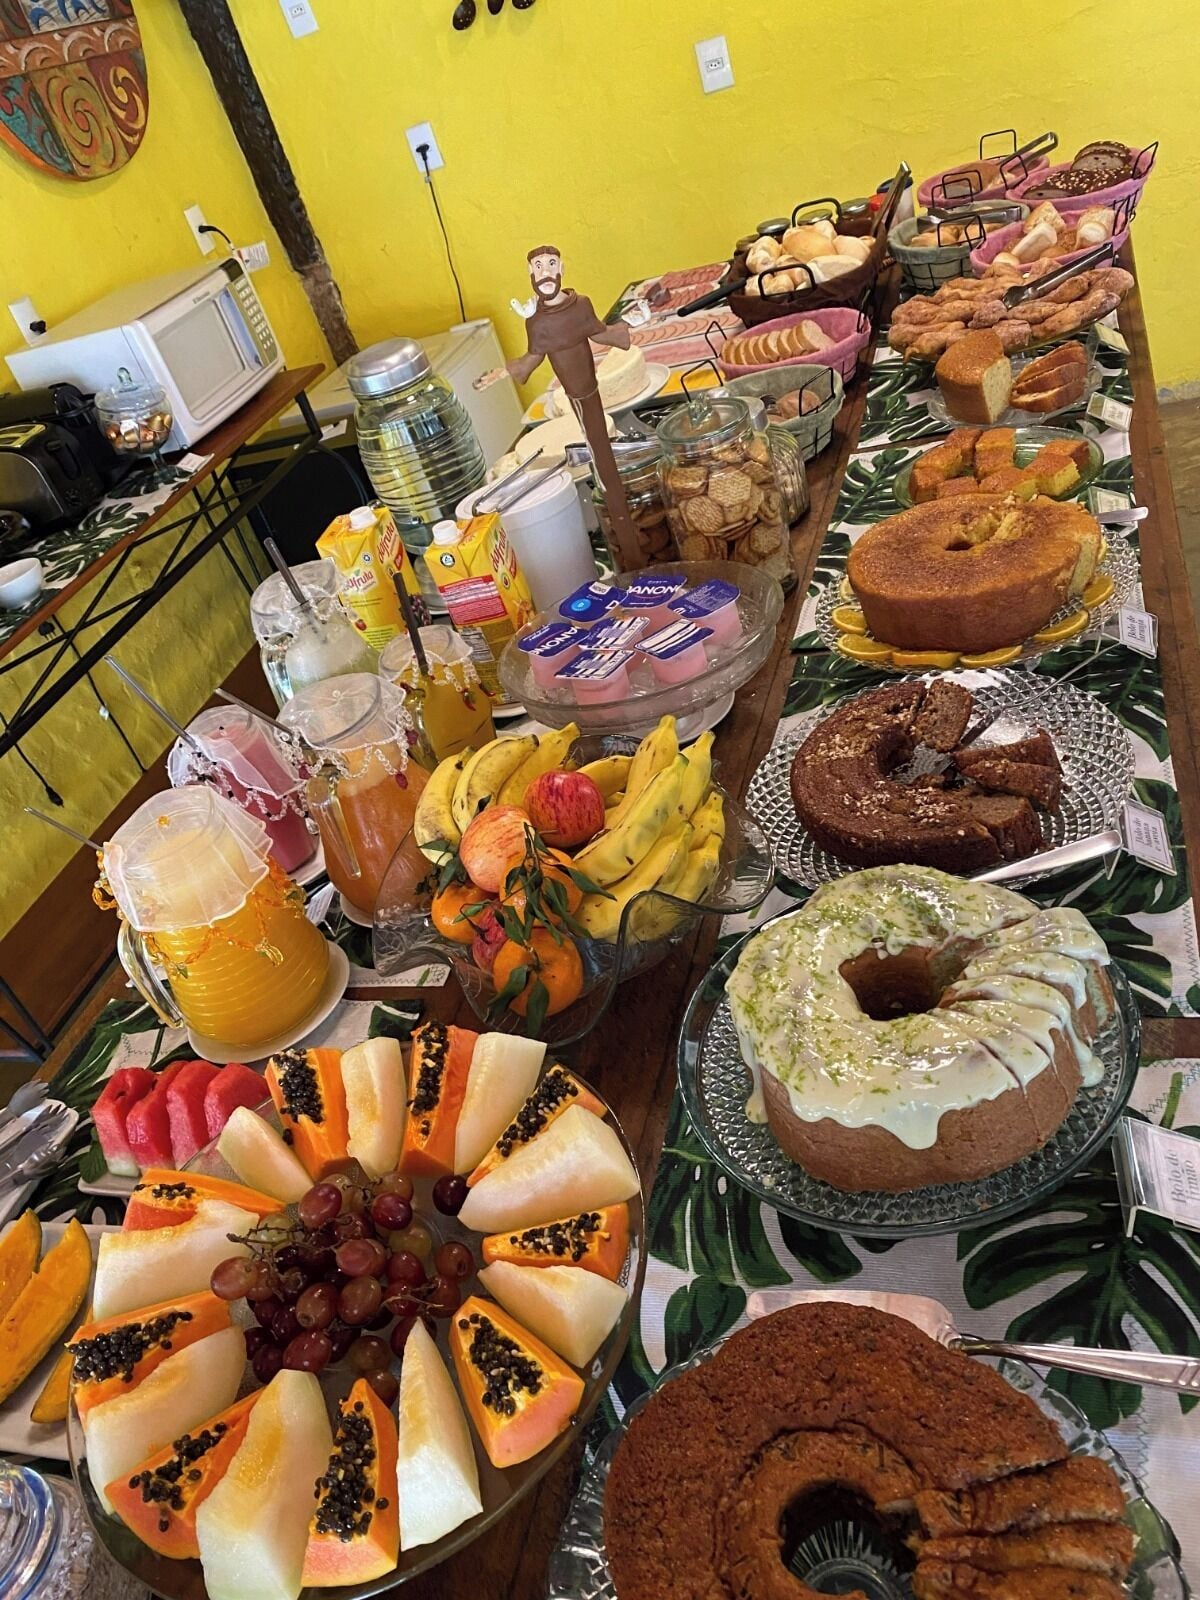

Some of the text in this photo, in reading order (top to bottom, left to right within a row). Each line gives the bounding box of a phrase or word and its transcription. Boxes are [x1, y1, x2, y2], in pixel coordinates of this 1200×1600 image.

[628, 584, 682, 597] ANON
[1164, 1148, 1187, 1204] Bolo de
